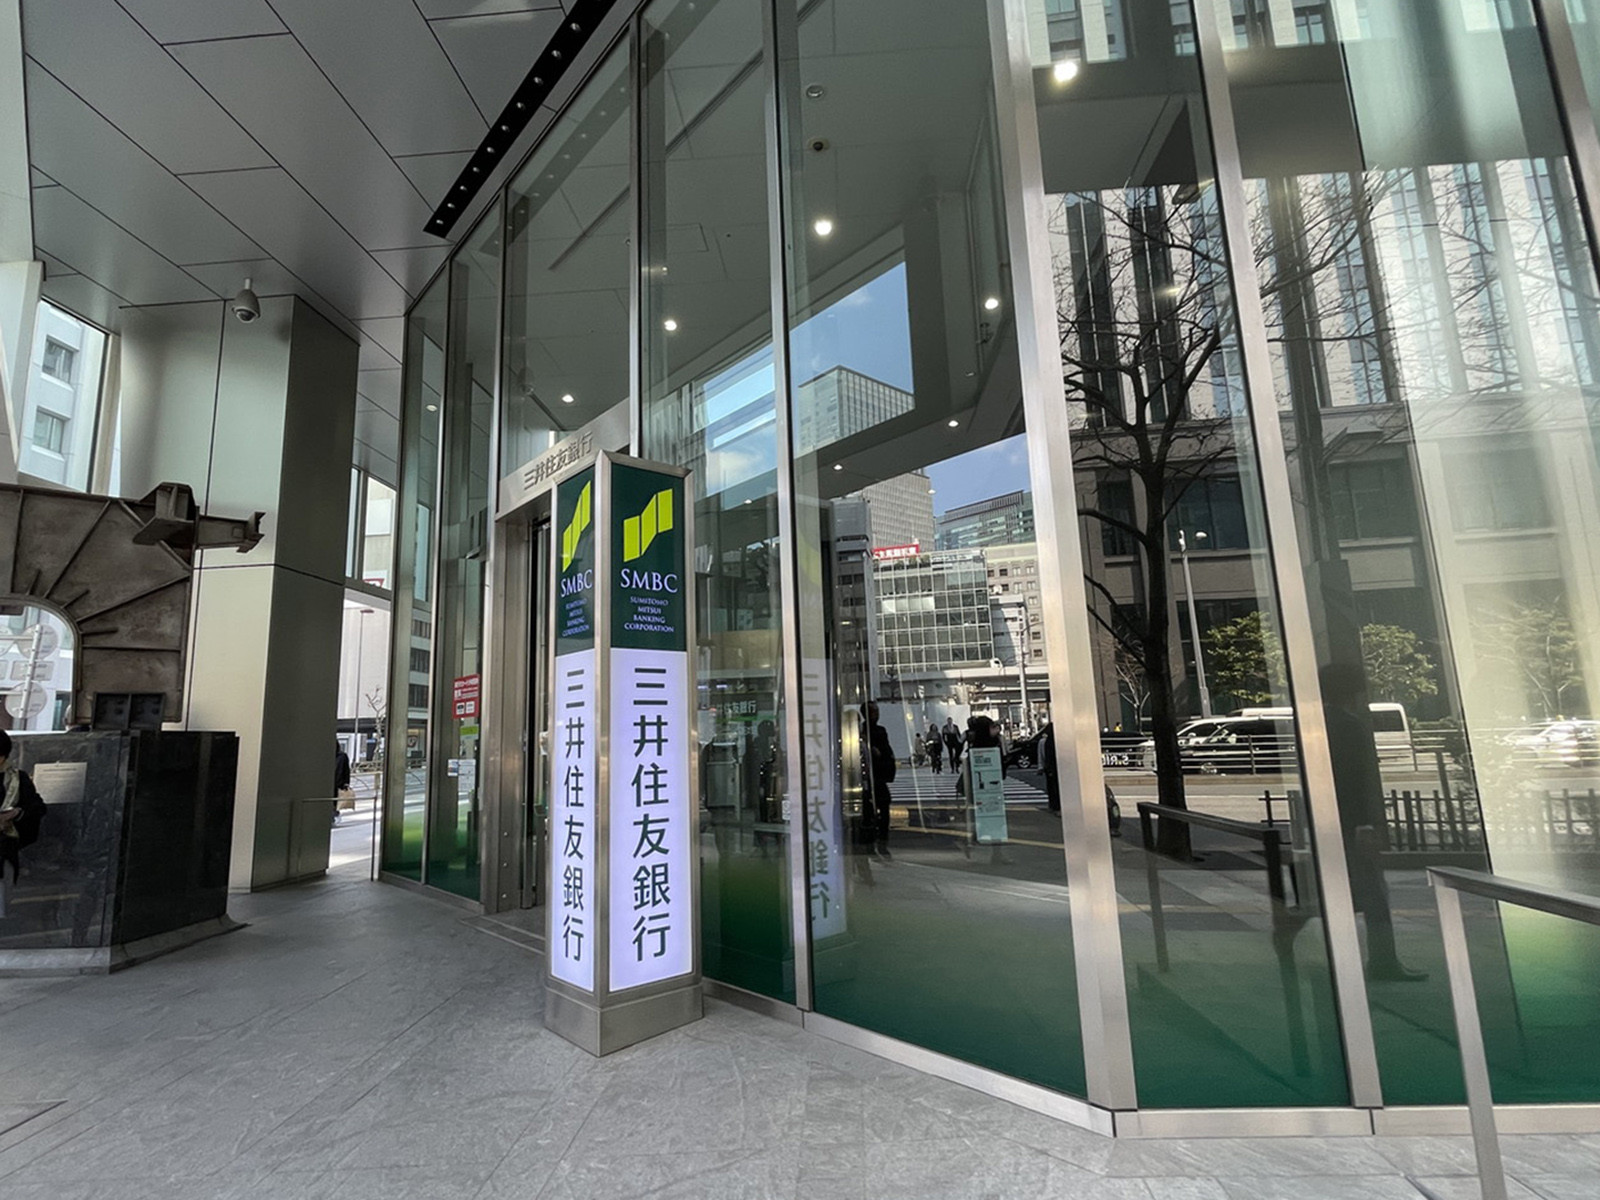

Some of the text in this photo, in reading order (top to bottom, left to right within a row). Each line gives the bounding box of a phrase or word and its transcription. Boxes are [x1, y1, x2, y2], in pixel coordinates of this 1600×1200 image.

[524, 431, 593, 490] 三井住友銀行
[561, 569, 593, 598] SMBC
[620, 567, 678, 594] SMBC
[630, 595, 669, 606] SUMITOMO
[637, 606, 662, 615] MITSUI
[623, 622, 675, 633] CORPORATION
[633, 614, 666, 624] BANKING
[562, 668, 585, 962] 三井住友銀行
[631, 666, 672, 963] 三井住友銀行
